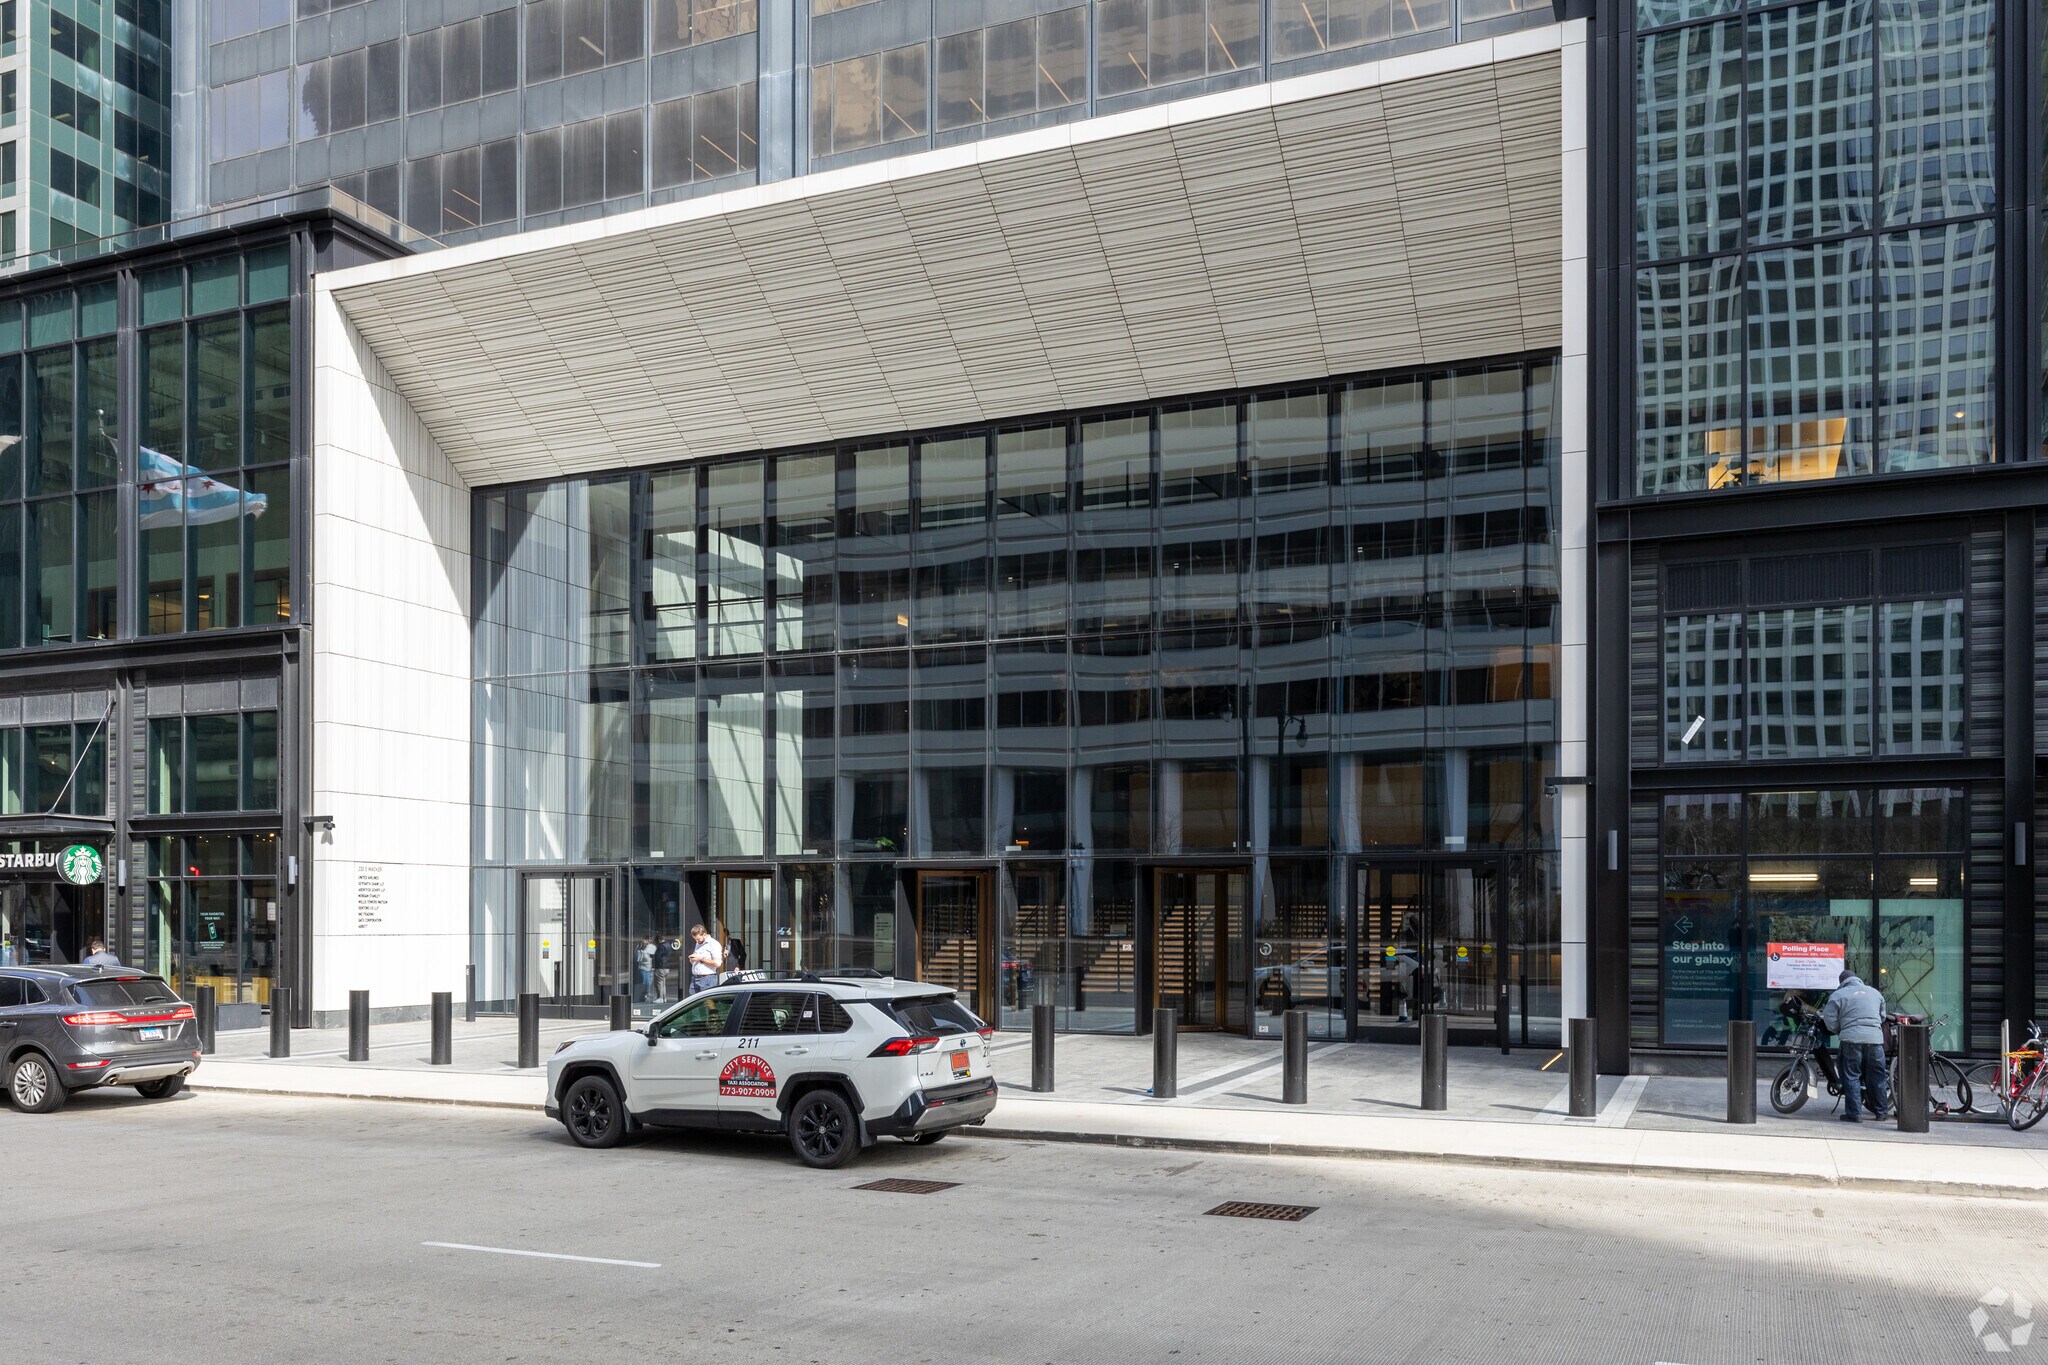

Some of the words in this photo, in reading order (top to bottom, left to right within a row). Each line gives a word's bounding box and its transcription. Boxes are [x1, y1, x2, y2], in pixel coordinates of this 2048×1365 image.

[1672, 941, 1700, 952] Step
[1702, 941, 1724, 950] into
[1672, 956, 1692, 964] our
[1695, 954, 1733, 966] galaxy
[738, 1037, 760, 1049] 211
[724, 1058, 739, 1075] CITY
[741, 1055, 773, 1077] SERVICE
[721, 1086, 775, 1097] 773-907-0909
